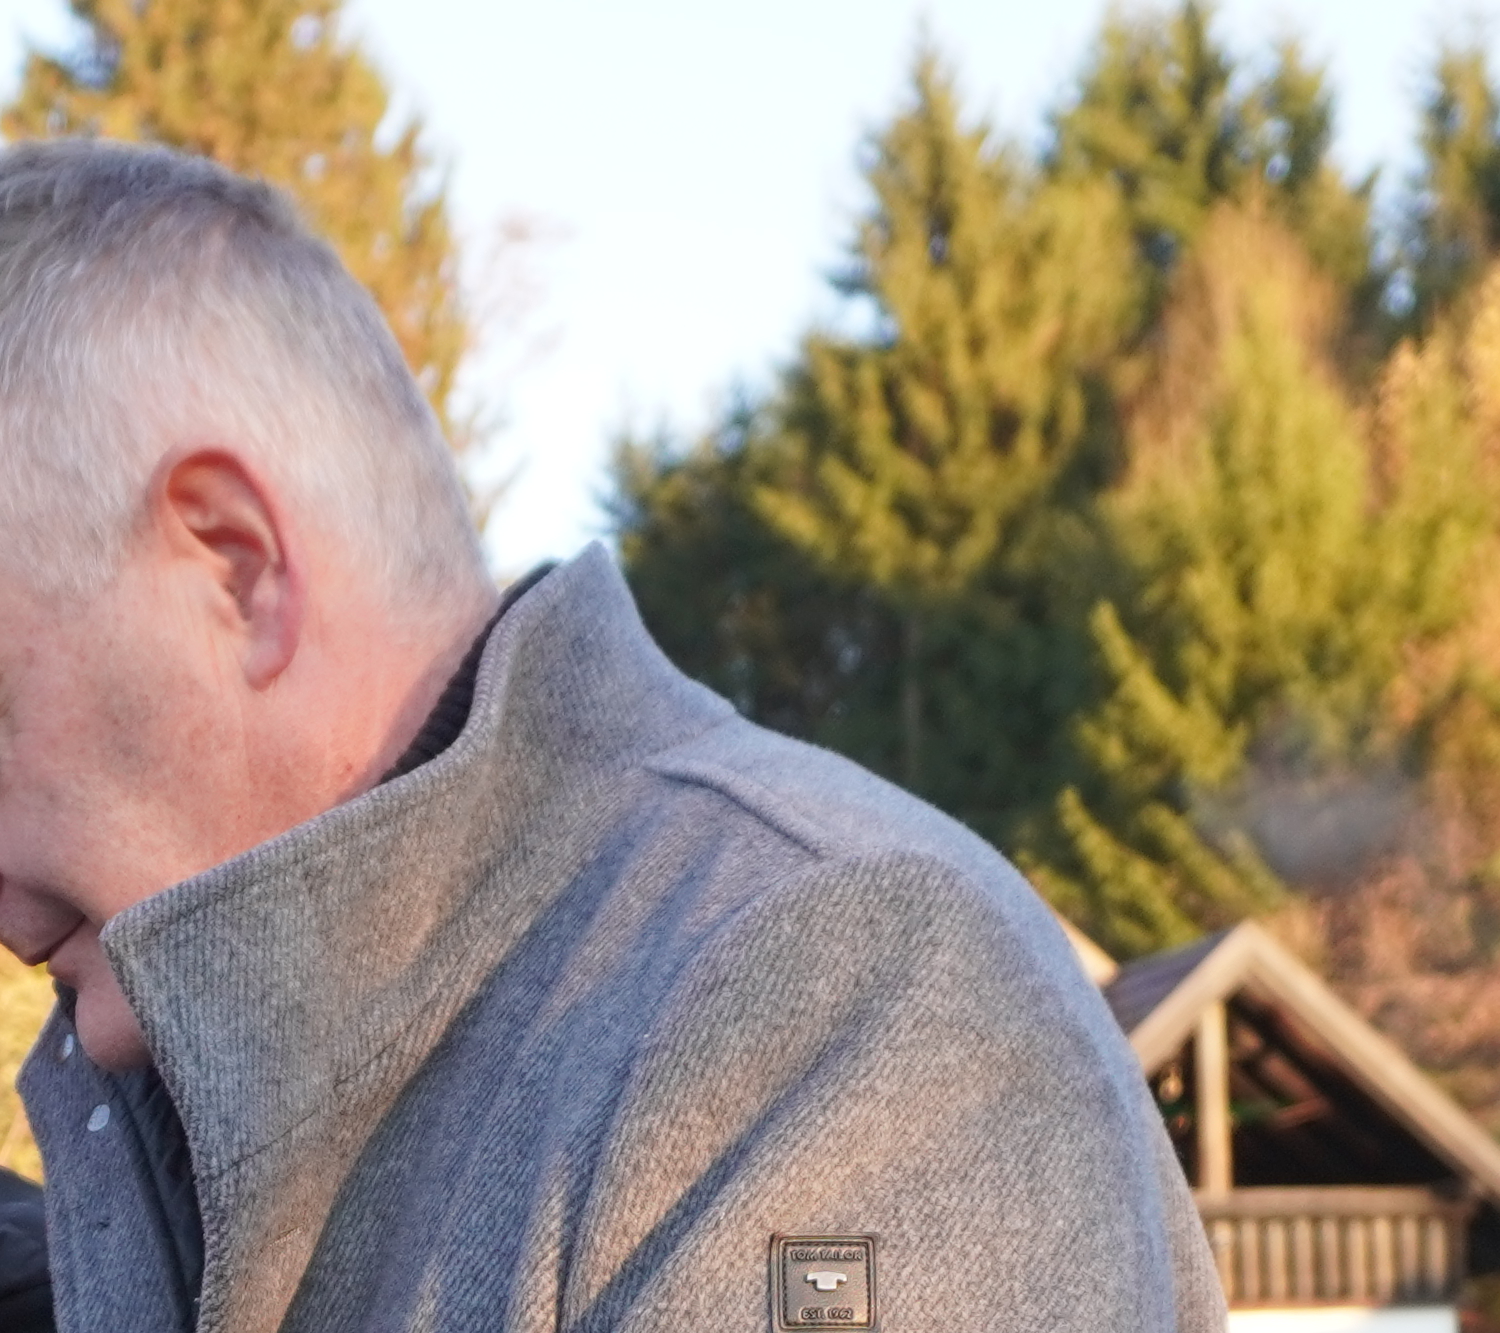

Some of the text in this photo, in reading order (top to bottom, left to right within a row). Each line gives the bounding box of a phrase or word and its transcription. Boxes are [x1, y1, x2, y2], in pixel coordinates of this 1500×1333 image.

[790, 1249, 864, 1261] TOM TAILOR
[827, 1307, 853, 1320] 1962
